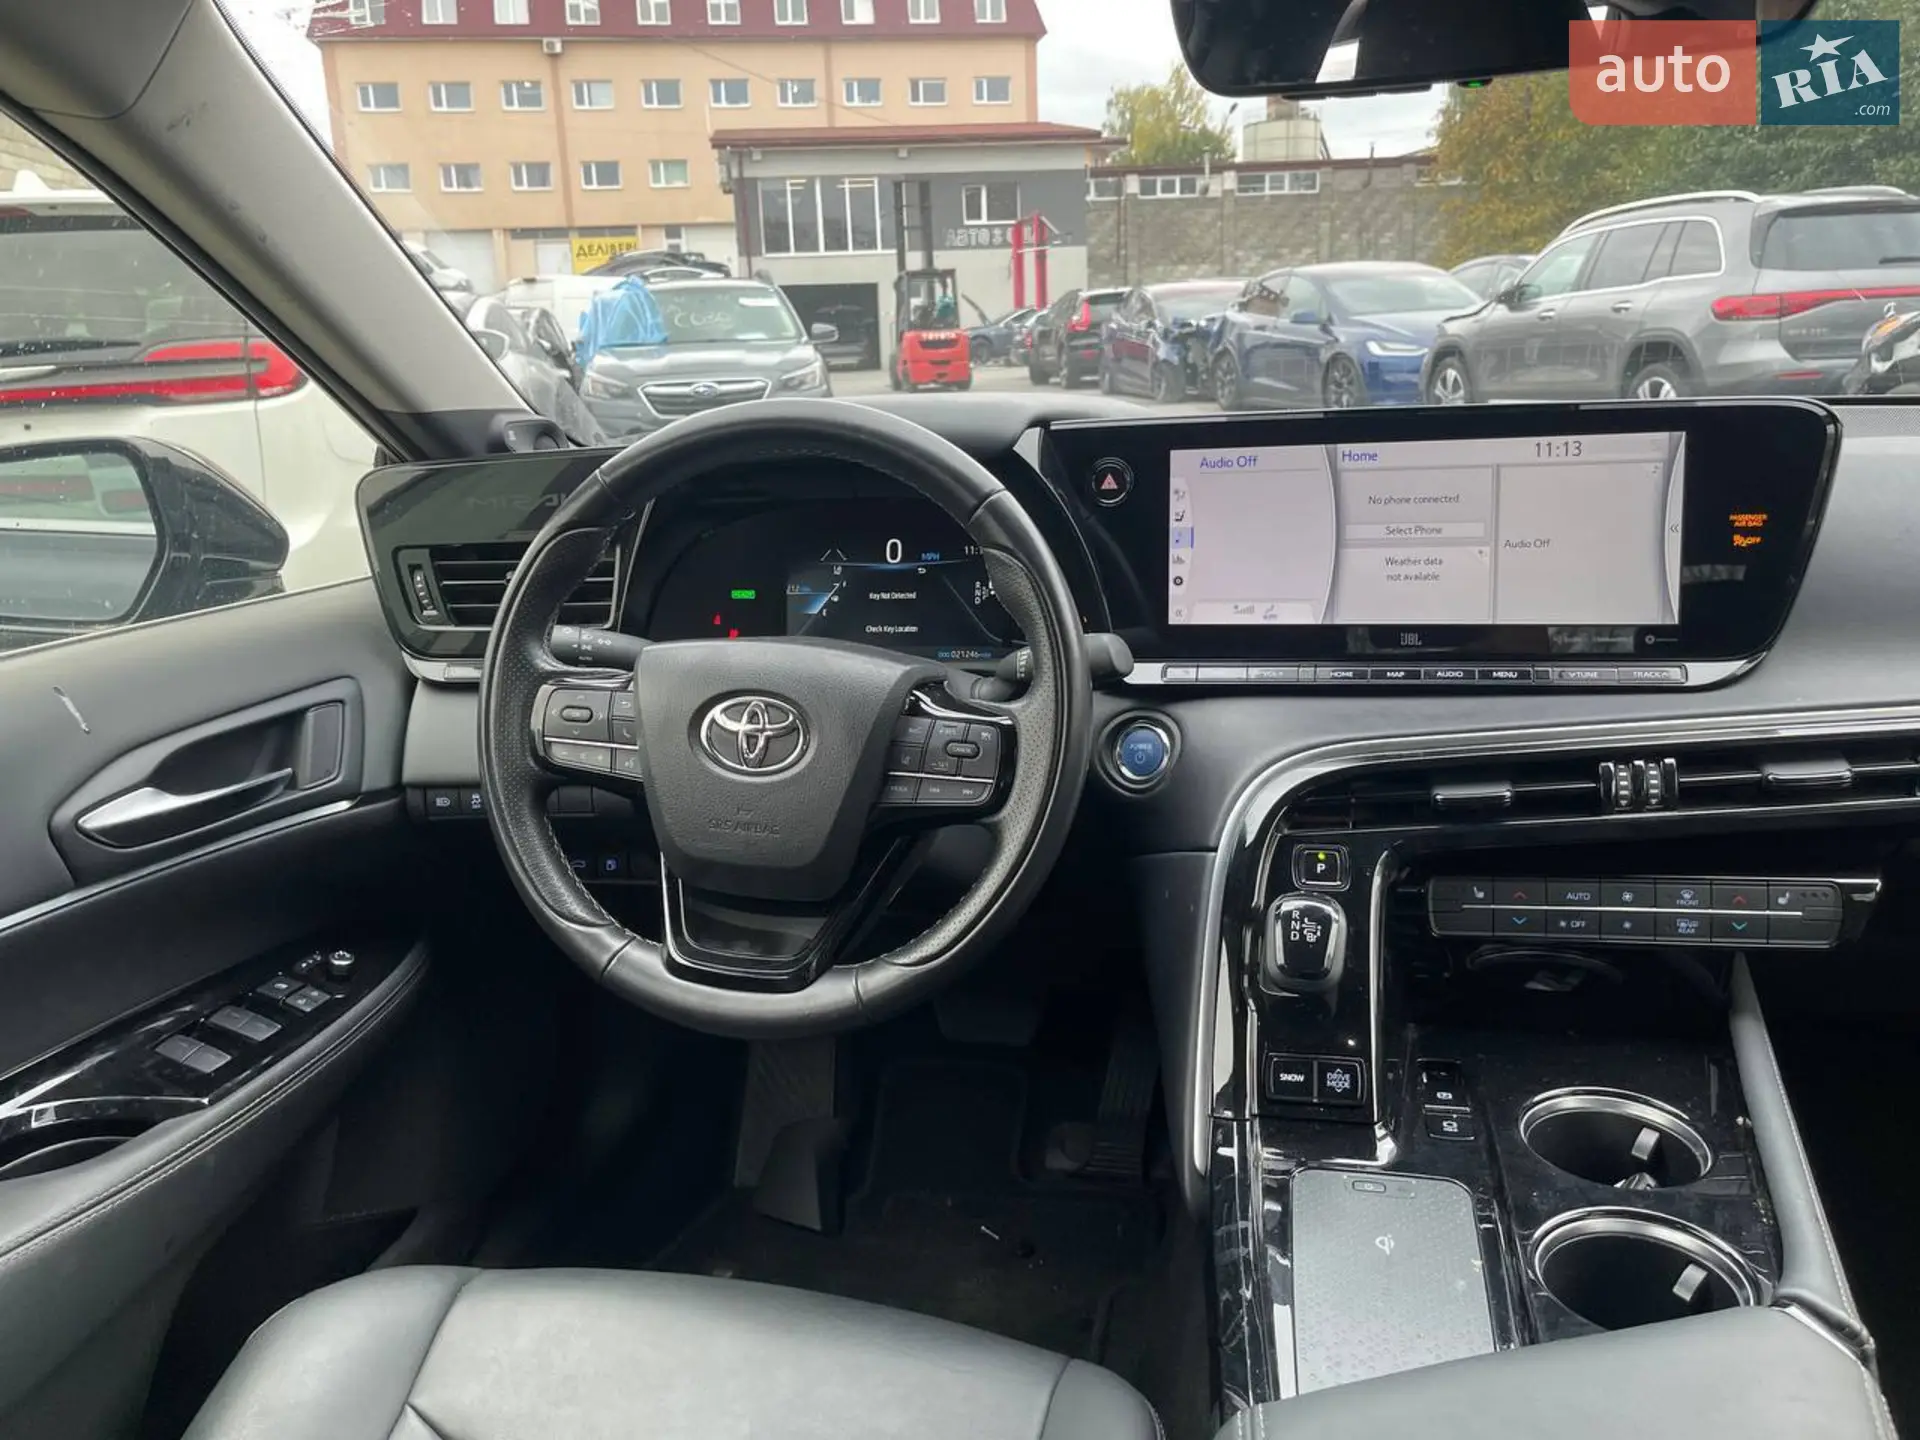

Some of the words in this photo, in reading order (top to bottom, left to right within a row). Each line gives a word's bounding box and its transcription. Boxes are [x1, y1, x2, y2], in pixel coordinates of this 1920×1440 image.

[1535, 440, 1583, 458] 11:13
[1341, 450, 1378, 462] Home
[1199, 456, 1234, 469] Audio
[1236, 455, 1259, 468] Off
[1368, 495, 1382, 505] No
[1384, 495, 1411, 506] phone
[1413, 493, 1460, 504] connected
[1385, 525, 1413, 536] Select
[1414, 525, 1443, 535] Phone
[1503, 539, 1532, 549] Audio
[1533, 538, 1550, 548] Off
[885, 538, 903, 564] 0
[1385, 556, 1423, 567] Weather
[1423, 556, 1444, 566] data
[1386, 572, 1402, 582] not
[1403, 571, 1440, 582] available
[869, 591, 880, 601] Key
[880, 591, 890, 600] Not
[890, 591, 917, 600] Detected
[864, 624, 883, 633] Check
[883, 625, 895, 634] Key
[895, 625, 919, 633] Location
[1400, 631, 1423, 646] JBL
[1329, 670, 1354, 678] HOME
[1492, 671, 1518, 679] MENU
[1576, 671, 1599, 679] TUNE
[1316, 863, 1326, 874] P
[1566, 892, 1591, 901] AUTO
[1292, 910, 1300, 919] R
[1290, 921, 1300, 930] N
[1570, 919, 1586, 928] OFF
[1290, 931, 1300, 941] D
[1279, 1072, 1305, 1083] SNOW
[1326, 1071, 1351, 1081] DRIVE
[1326, 1080, 1351, 1089] MODE
